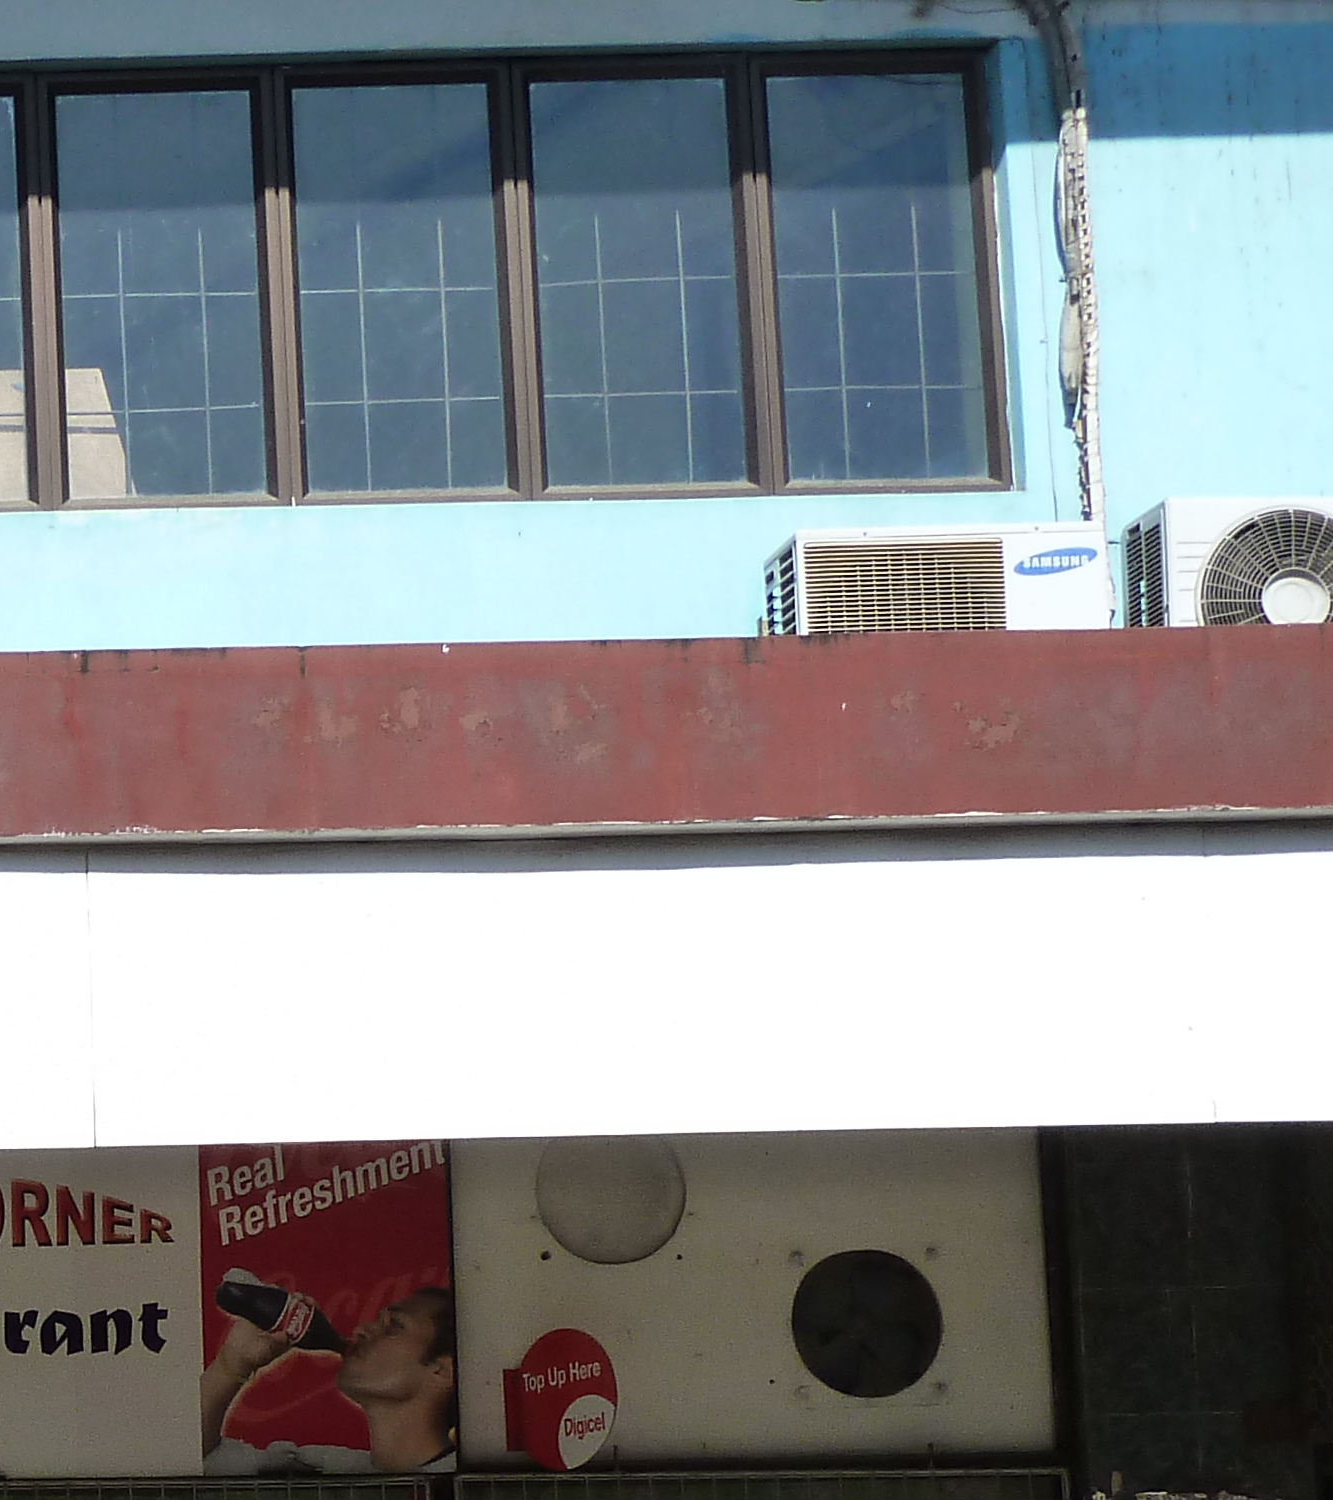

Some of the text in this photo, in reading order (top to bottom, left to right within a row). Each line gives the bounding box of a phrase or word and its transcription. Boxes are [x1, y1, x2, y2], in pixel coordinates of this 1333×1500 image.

[1021, 554, 1089, 568] SAMSUNG
[207, 1143, 286, 1206] Real
[219, 1140, 446, 1246] Refreshment
[522, 1360, 602, 1395] Top Up Here
[563, 1411, 607, 1441] Digicel
